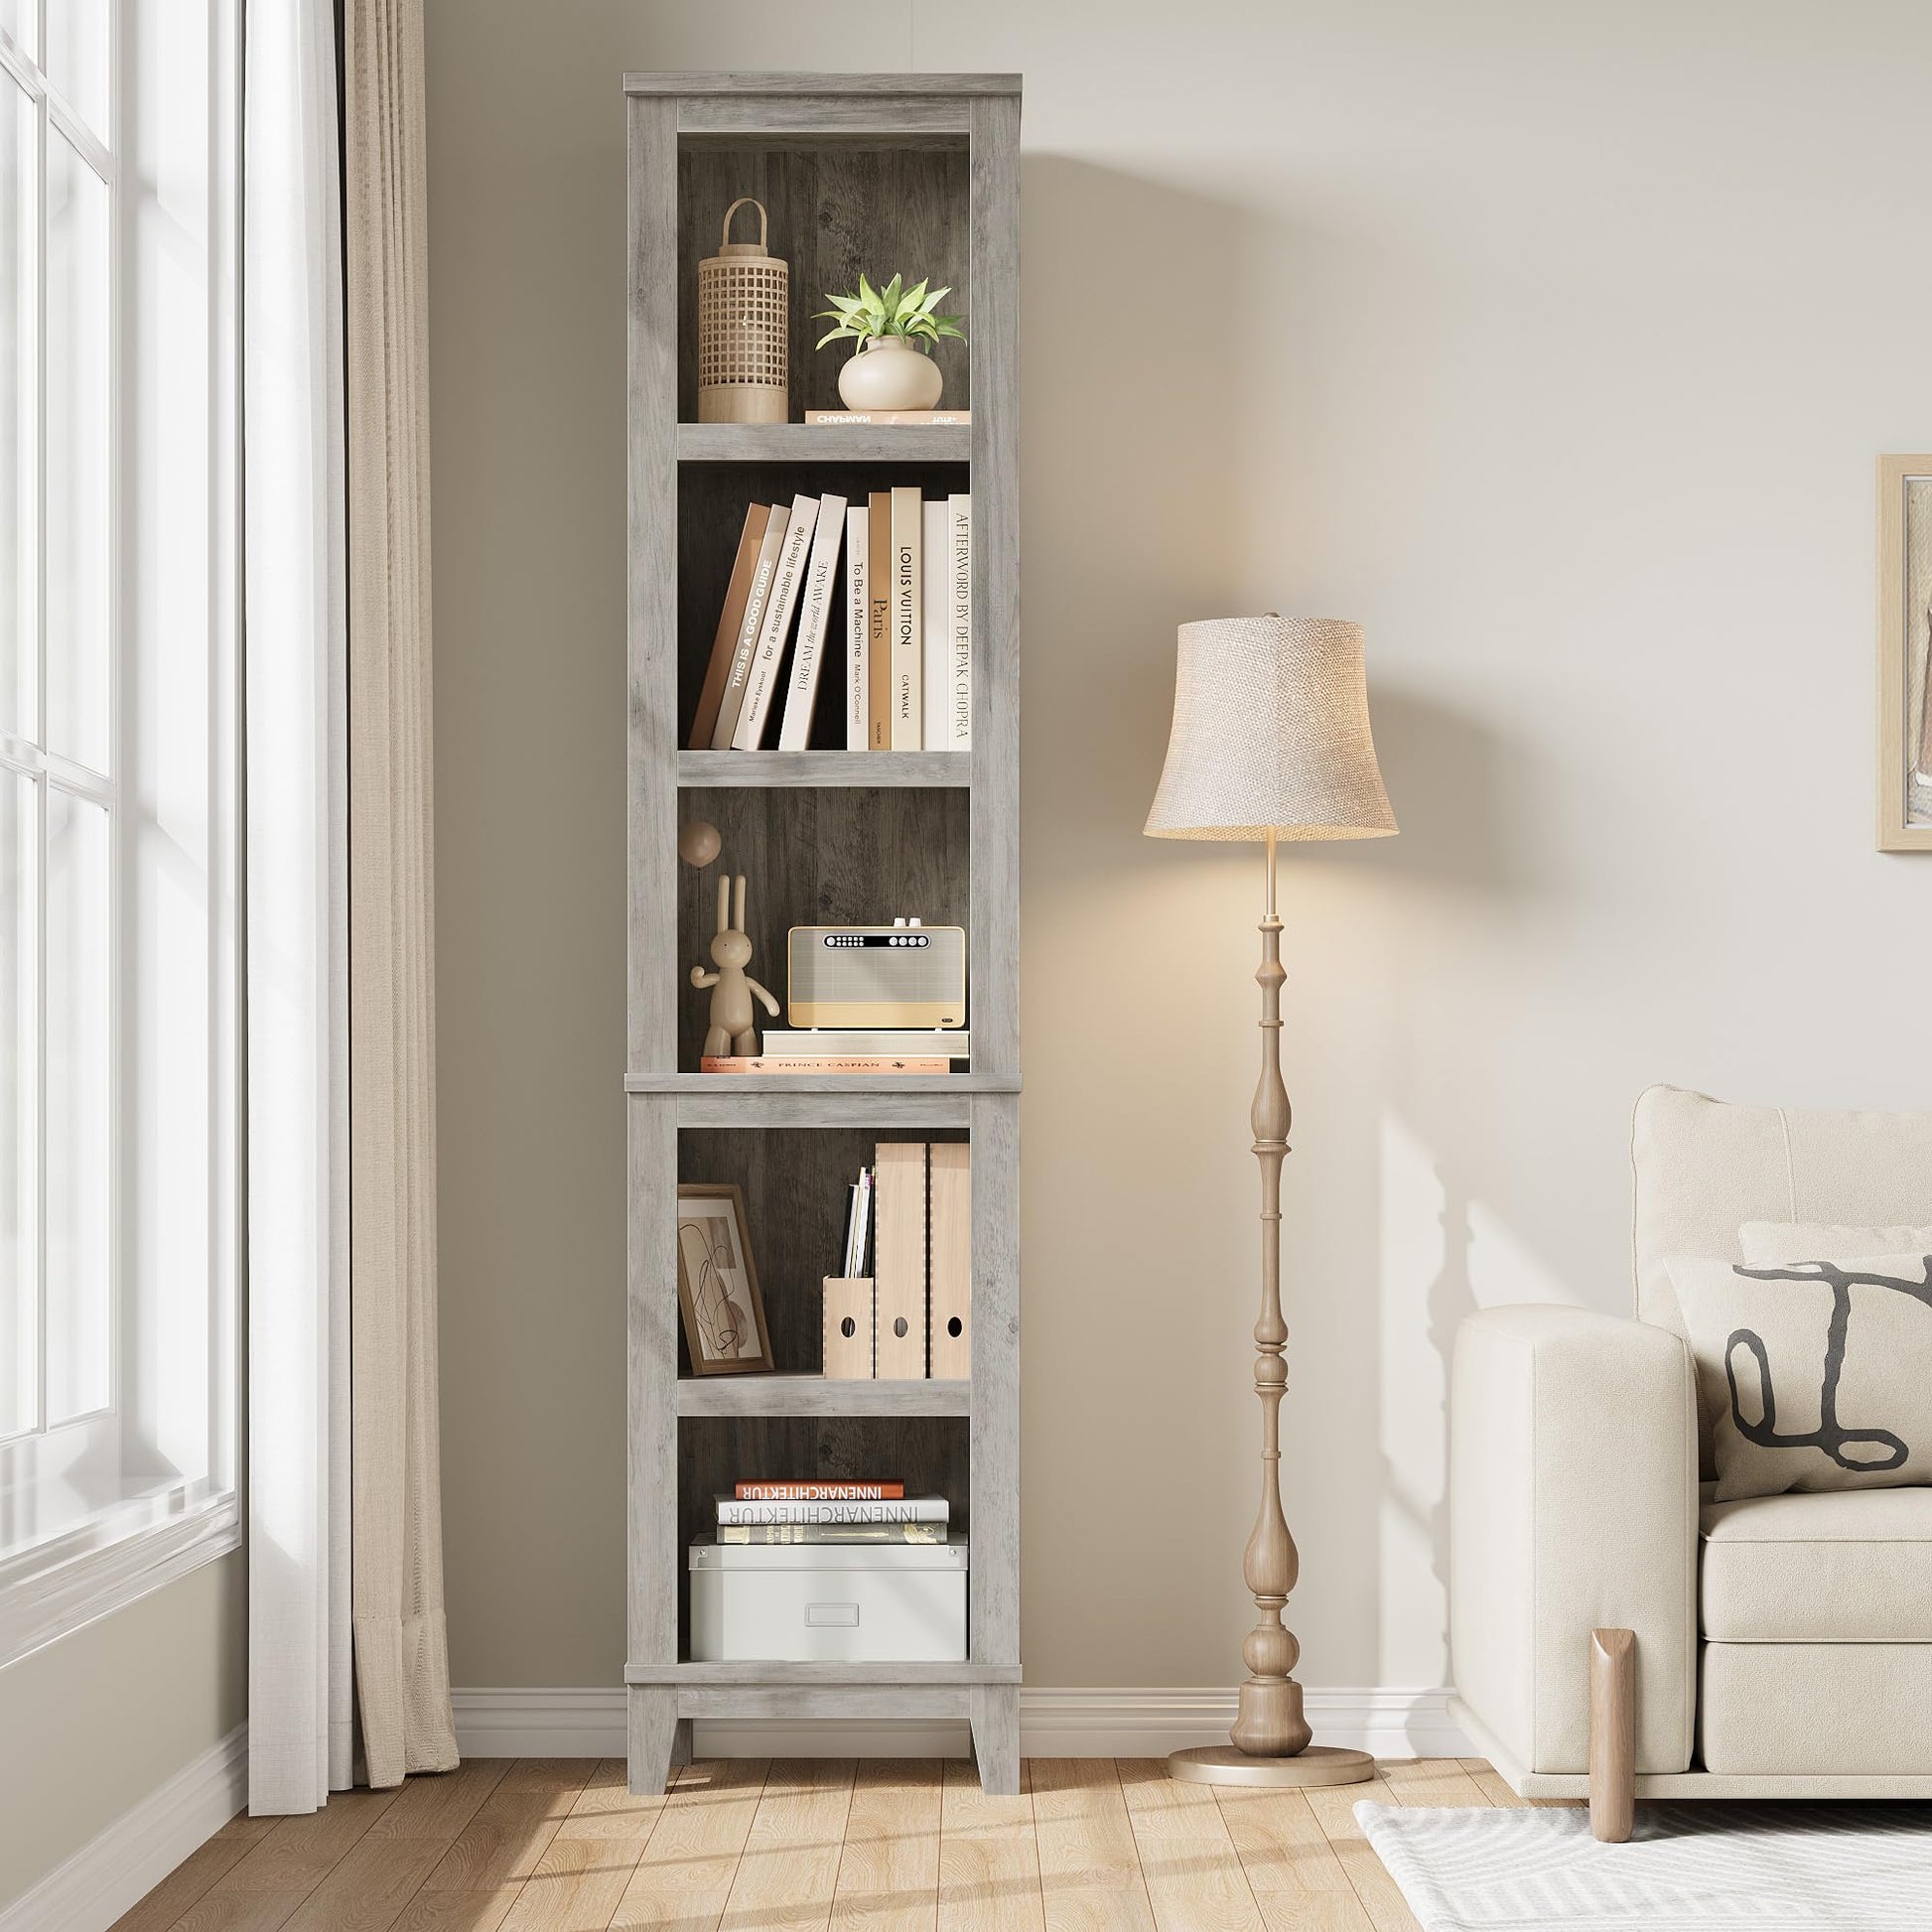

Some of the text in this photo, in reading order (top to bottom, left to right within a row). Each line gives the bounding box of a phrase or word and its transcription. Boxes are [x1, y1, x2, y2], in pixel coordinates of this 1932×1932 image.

[762, 645, 774, 661] for
[771, 571, 793, 633] sustainable
[785, 526, 805, 568] lifestyle
[853, 562, 864, 576] To
[853, 579, 864, 595] Be
[874, 599, 889, 639] Paris
[900, 546, 912, 645] LOUIS VUITTON
[732, 661, 746, 688] THIS
[740, 648, 750, 661] IS
[746, 599, 761, 634] GOOD
[756, 559, 772, 598] GUIDE
[797, 560, 829, 691] DREAM the world AWAKE
[853, 609, 864, 658] Machine
[956, 512, 969, 739] AFTERWORD BY DEEPAK CHOPRA
[729, 1506, 918, 1524] INNENARCHITEKTUR
[743, 1486, 882, 1500] INNENARCHITEKTUR
